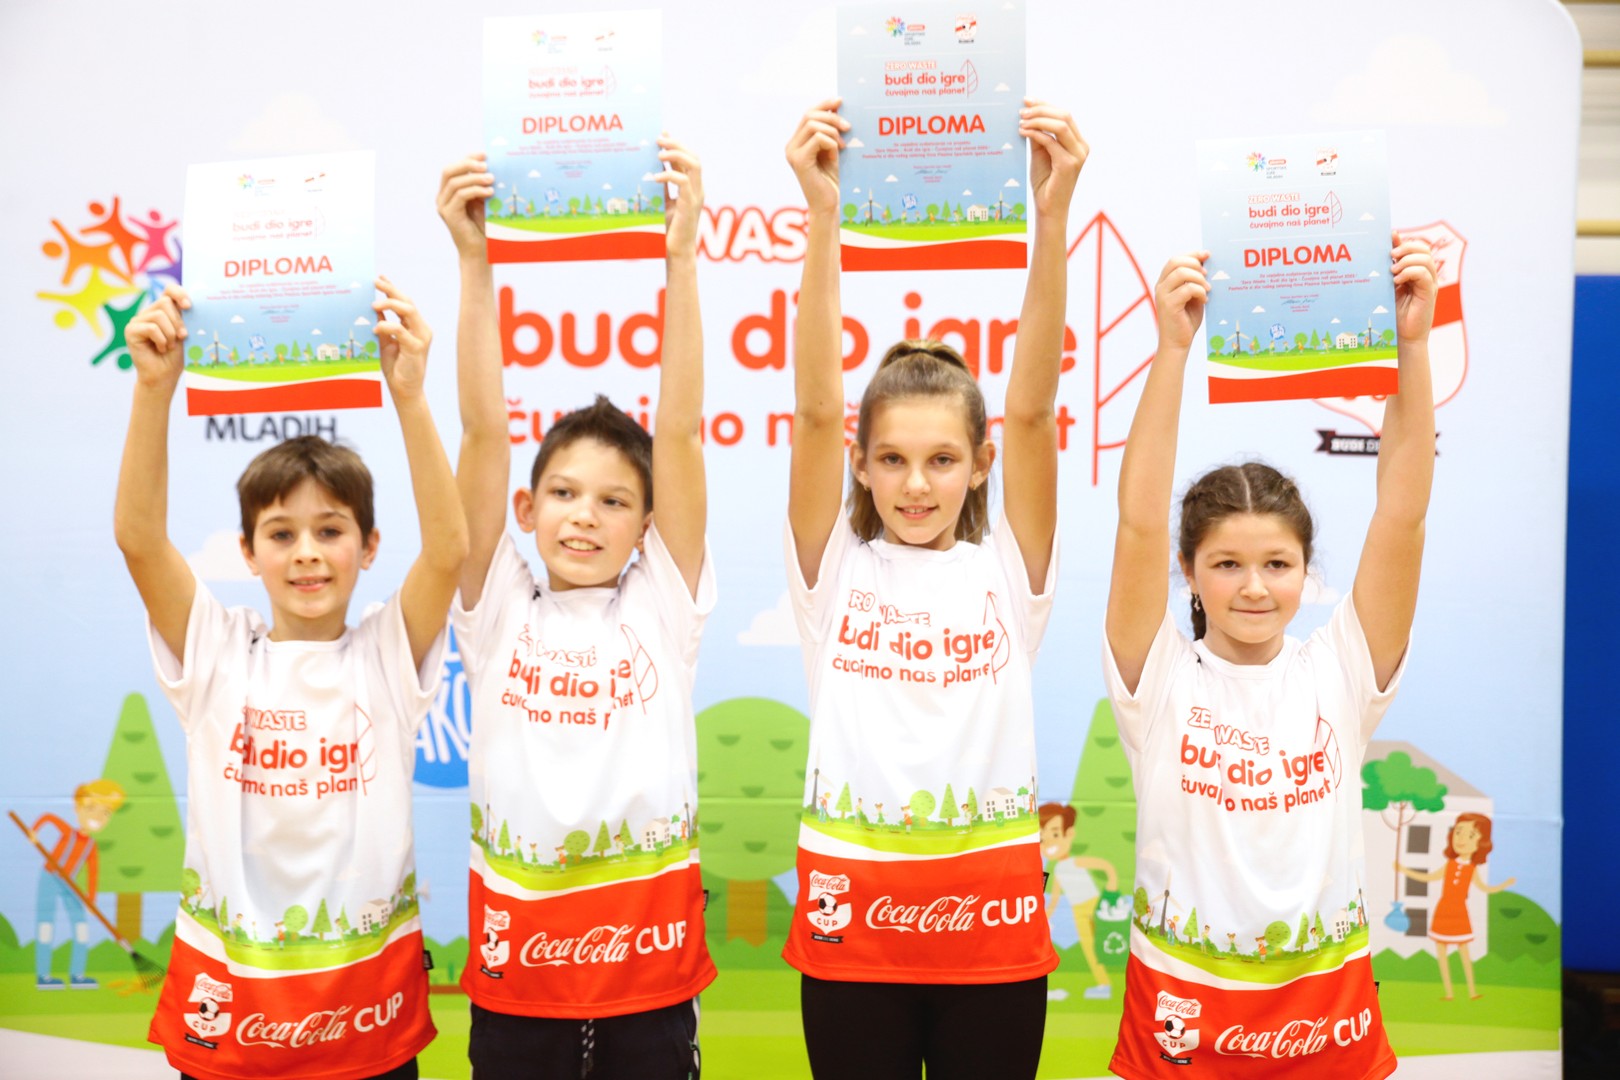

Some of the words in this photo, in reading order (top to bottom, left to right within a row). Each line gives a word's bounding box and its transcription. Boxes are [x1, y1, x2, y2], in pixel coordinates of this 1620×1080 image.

[528, 77, 554, 89] budi
[559, 77, 577, 88] dio
[581, 77, 605, 90] igre
[885, 73, 912, 85] budi
[917, 73, 936, 85] dio
[940, 72, 965, 87] igre
[939, 87, 965, 96] planet
[522, 113, 624, 134] DIPLOMA
[879, 114, 986, 136] DIPLOMA
[1248, 194, 1271, 204] ZERO
[1272, 193, 1300, 203] WASTE
[1249, 206, 1276, 218] budi
[1281, 204, 1300, 217] dio
[1305, 203, 1329, 218] igre
[288, 218, 313, 231] igre
[1249, 220, 1284, 229] čuvajmo
[1287, 219, 1301, 227] naš
[1304, 217, 1330, 227] planet
[696, 206, 809, 263] WAS
[1244, 243, 1352, 268] DIPLOMA
[224, 255, 333, 278] DIPLOMA
[500, 287, 667, 369] bud
[205, 415, 337, 442] MLADIH
[943, 628, 995, 664] igre
[550, 672, 599, 698] dio
[559, 708, 596, 725] naš
[1187, 706, 1213, 731] ZE
[260, 739, 308, 769] dio
[1227, 759, 1273, 787] dio
[271, 778, 308, 797] naš
[1241, 792, 1278, 812] naš
[817, 917, 838, 927] CUP
[865, 895, 981, 933] Coca-Cola
[981, 895, 1038, 927] CUP
[519, 924, 636, 968] Coca-Cola
[635, 920, 687, 955] CUP
[1159, 995, 1199, 1016] Coca-Cola
[192, 1020, 216, 1032] CUP
[236, 1005, 353, 1049] Coca-Cola
[354, 991, 403, 1033] CUP
[1214, 1016, 1329, 1059] Coca-Cola
[1334, 1007, 1372, 1047] CUP
[1161, 1040, 1187, 1049] CUP
